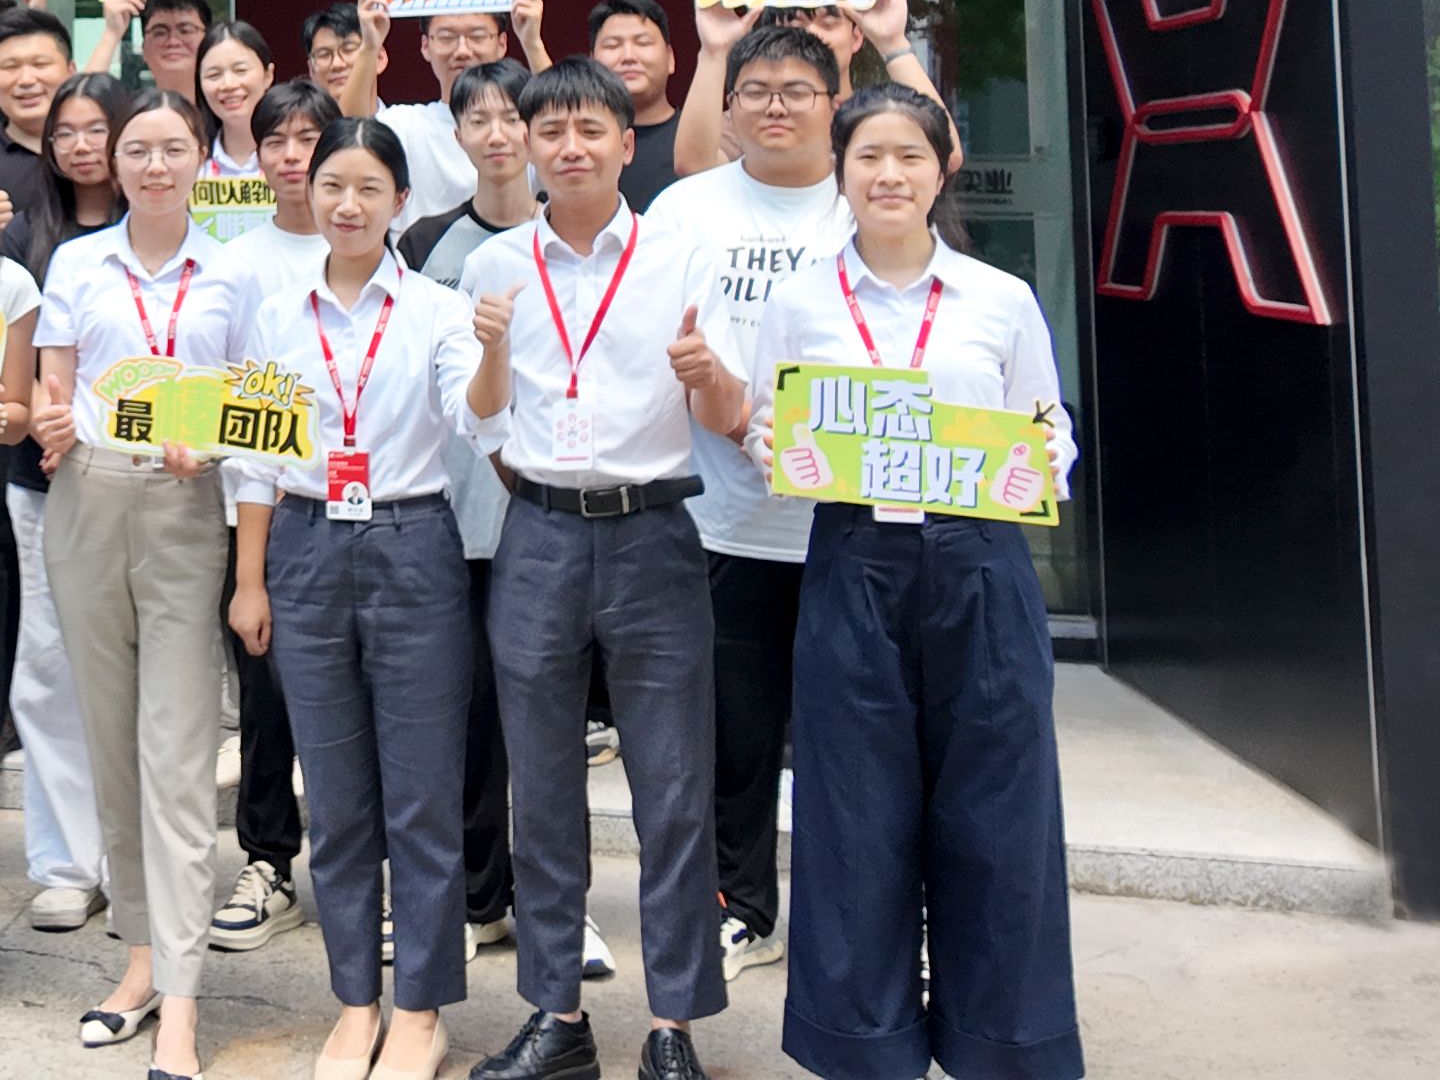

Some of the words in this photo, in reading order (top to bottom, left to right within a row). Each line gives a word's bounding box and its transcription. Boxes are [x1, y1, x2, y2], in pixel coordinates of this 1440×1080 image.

[726, 246, 807, 273] THEY
[810, 375, 933, 442] 心态
[861, 440, 987, 508] 超好
